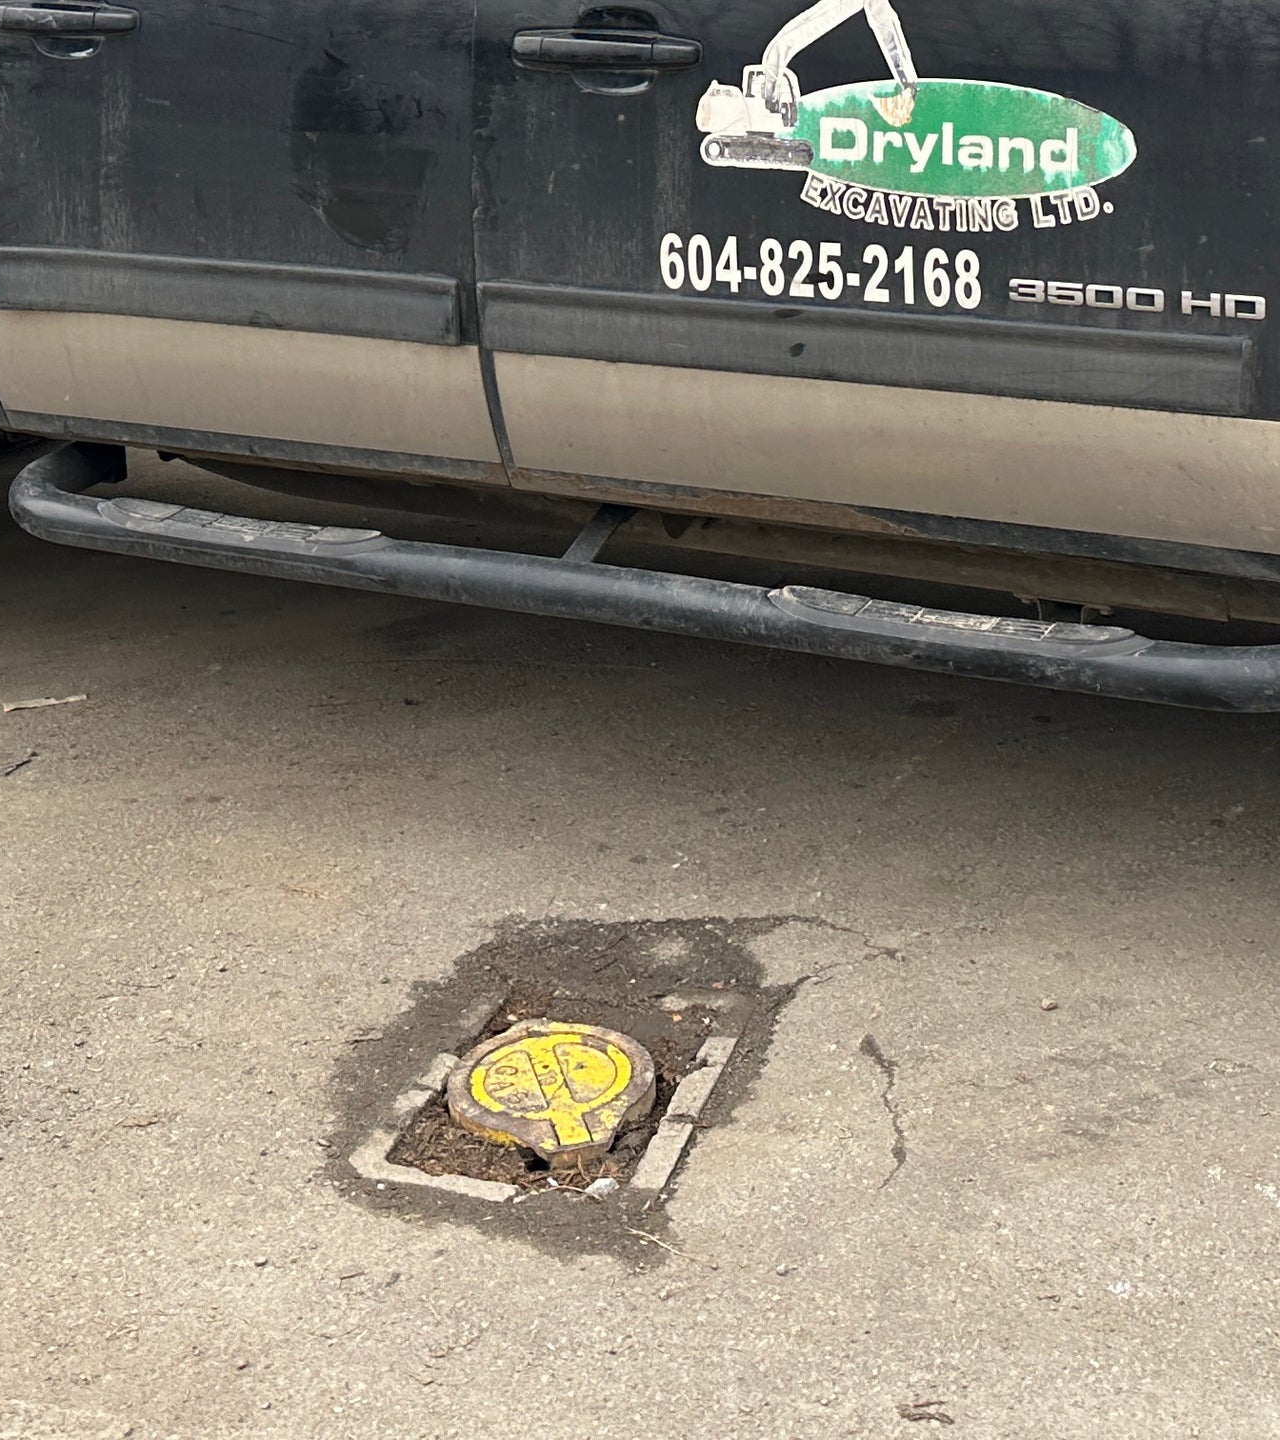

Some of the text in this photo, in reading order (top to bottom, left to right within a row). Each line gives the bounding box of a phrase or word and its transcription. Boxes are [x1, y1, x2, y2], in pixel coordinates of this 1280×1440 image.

[819, 116, 1079, 175] Dryland
[800, 171, 1116, 233] EXCAVATING LTD.
[658, 231, 984, 310] 604-825-2168
[1008, 277, 1268, 321] 3500 HD
